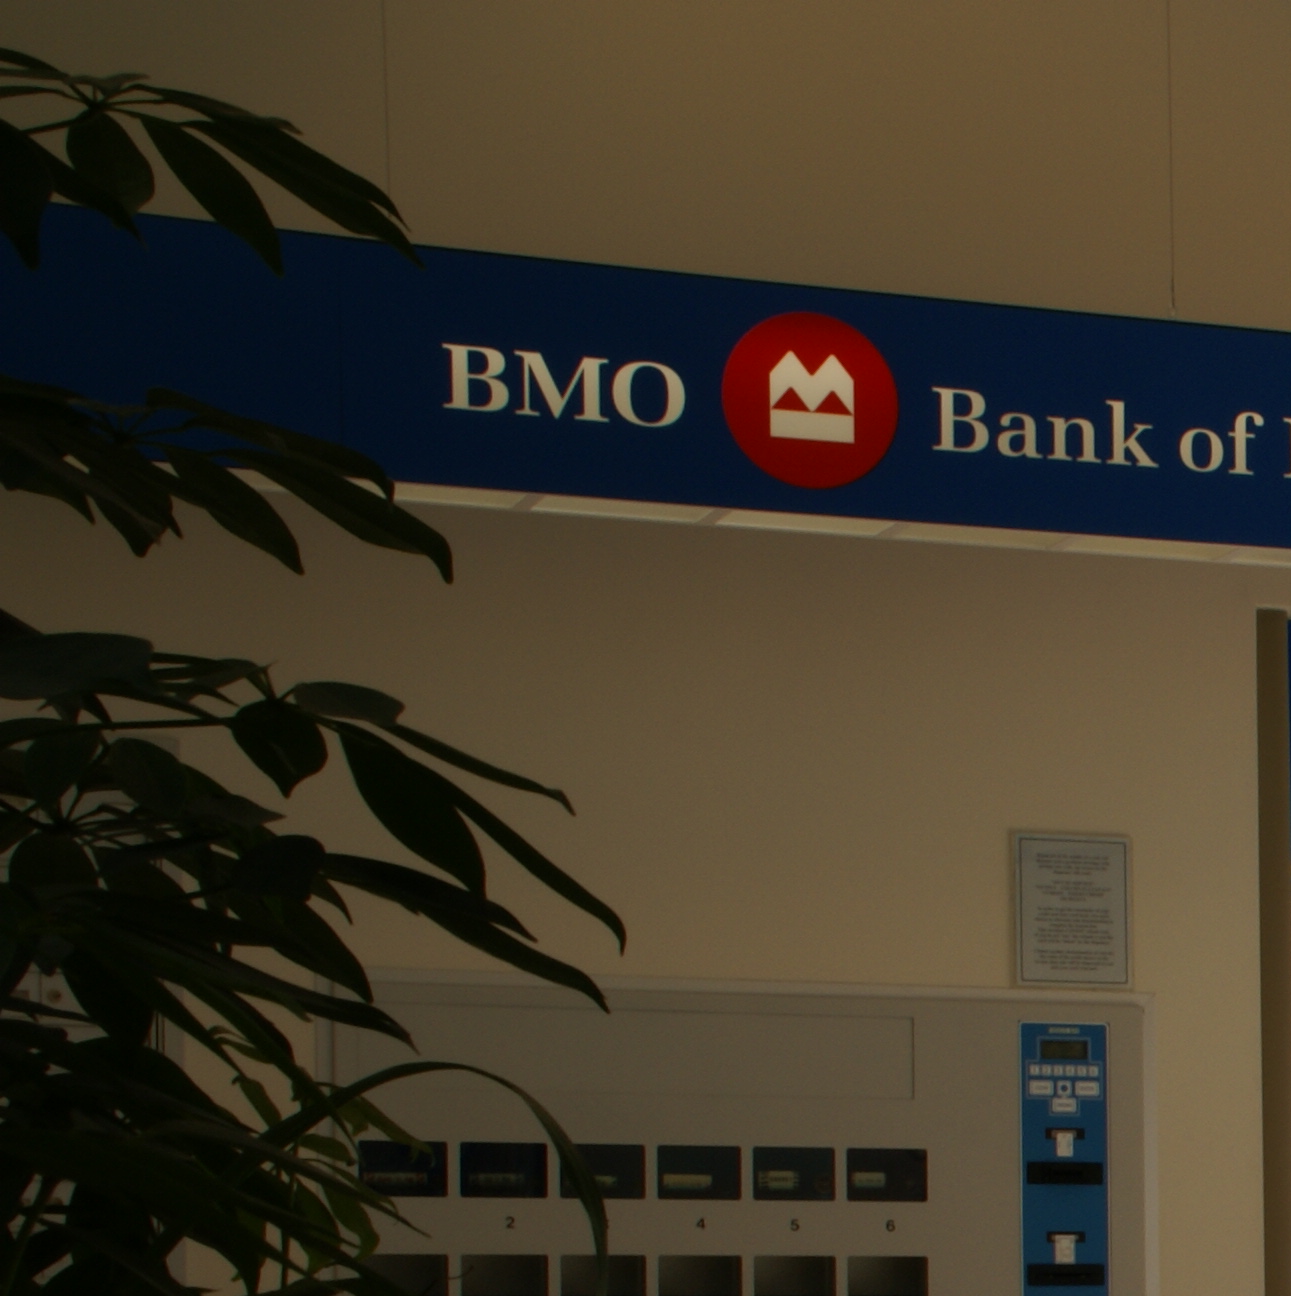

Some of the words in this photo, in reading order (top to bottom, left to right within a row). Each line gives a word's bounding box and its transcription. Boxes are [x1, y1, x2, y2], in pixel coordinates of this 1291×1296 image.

[441, 344, 687, 428] BMO
[932, 386, 1160, 470] Bank
[1179, 412, 1266, 476] of
[505, 1216, 515, 1230] 2
[696, 1217, 706, 1230] 4
[790, 1219, 800, 1232] 5
[886, 1220, 896, 1233] 6
